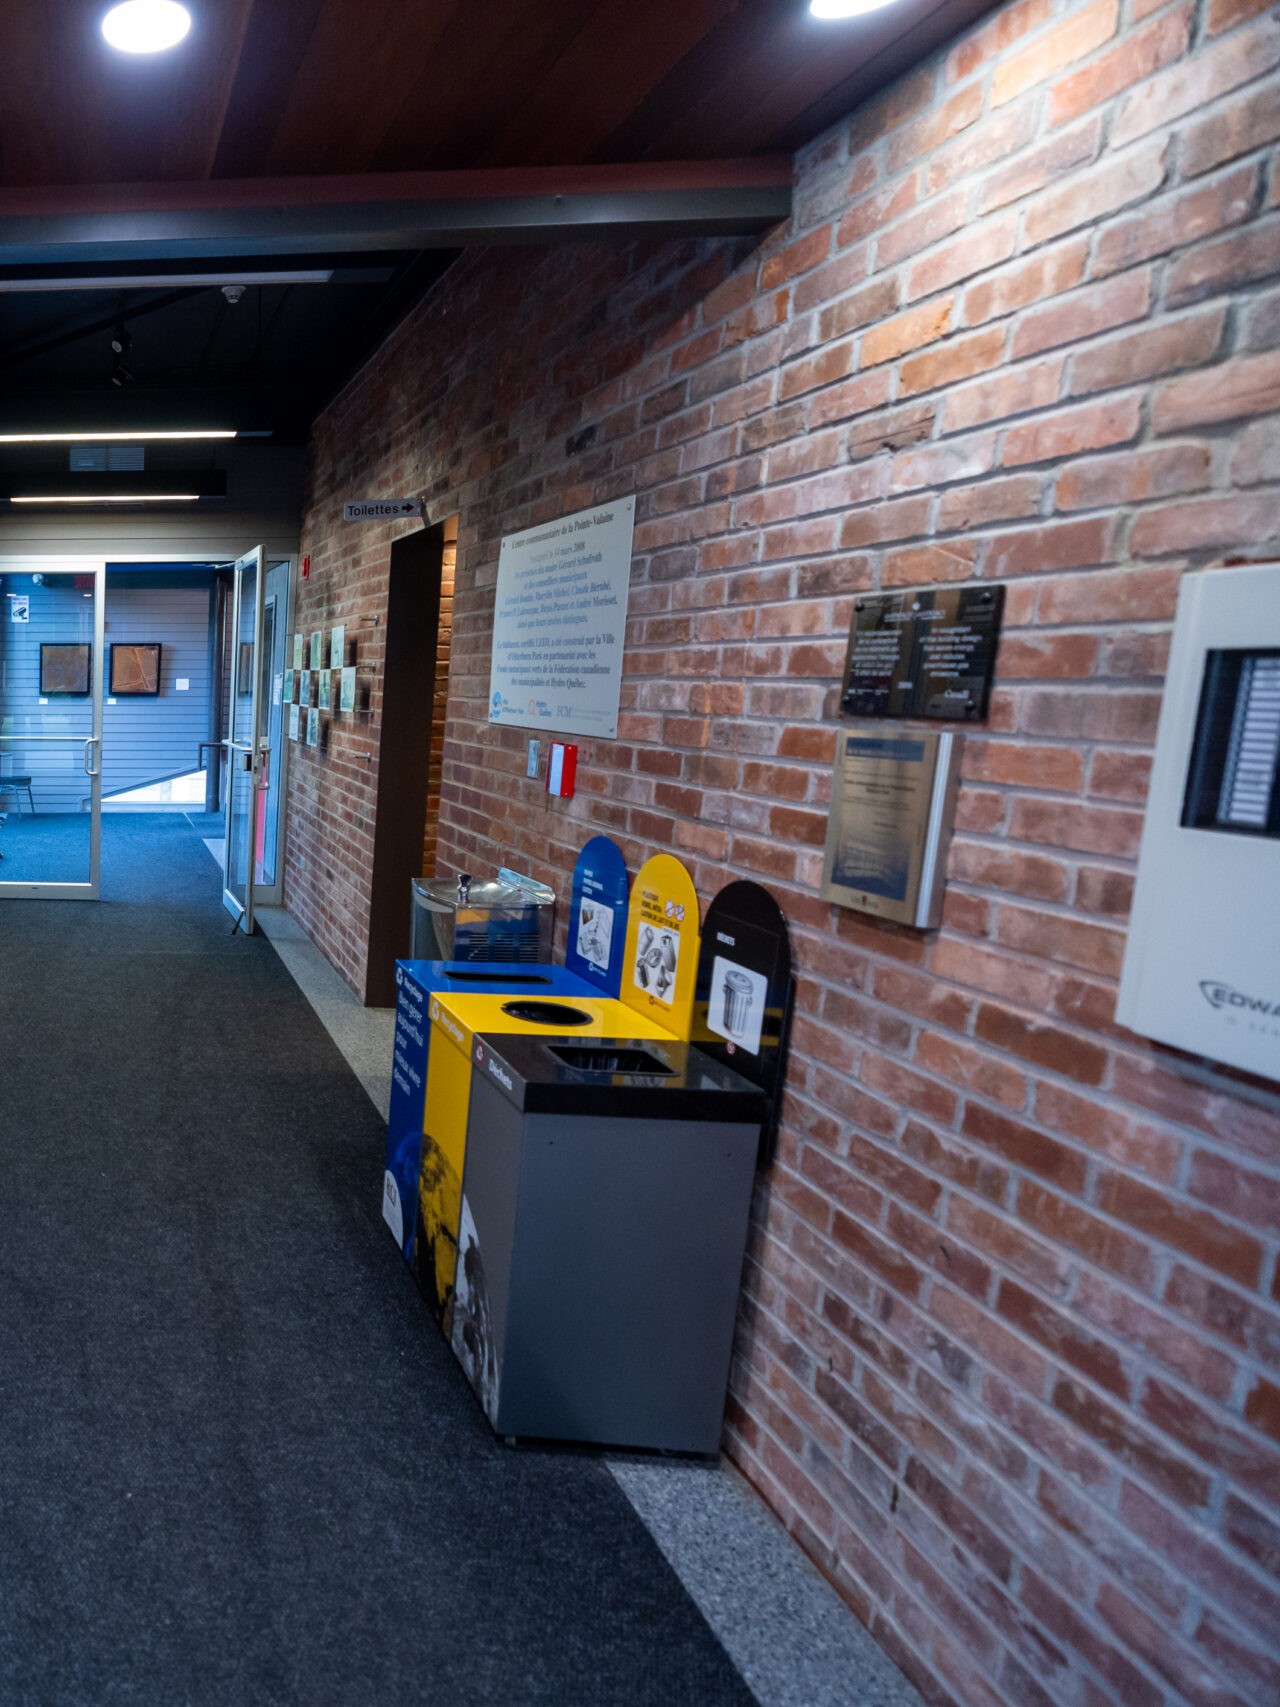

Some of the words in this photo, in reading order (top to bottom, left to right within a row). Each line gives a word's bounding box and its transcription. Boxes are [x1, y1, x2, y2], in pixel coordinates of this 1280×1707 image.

[348, 505, 399, 516] Toilettes
[403, 975, 423, 1005] Recyclage
[398, 988, 409, 1012] Bien
[408, 1001, 422, 1028] gérer
[396, 1029, 407, 1051] pour
[397, 1008, 423, 1049] aujourd'hui
[442, 1012, 464, 1042] Recyclage
[393, 1065, 410, 1097] demain
[394, 1047, 408, 1074] mieux
[408, 1063, 420, 1089] vivre
[488, 1058, 513, 1091] Déchets
